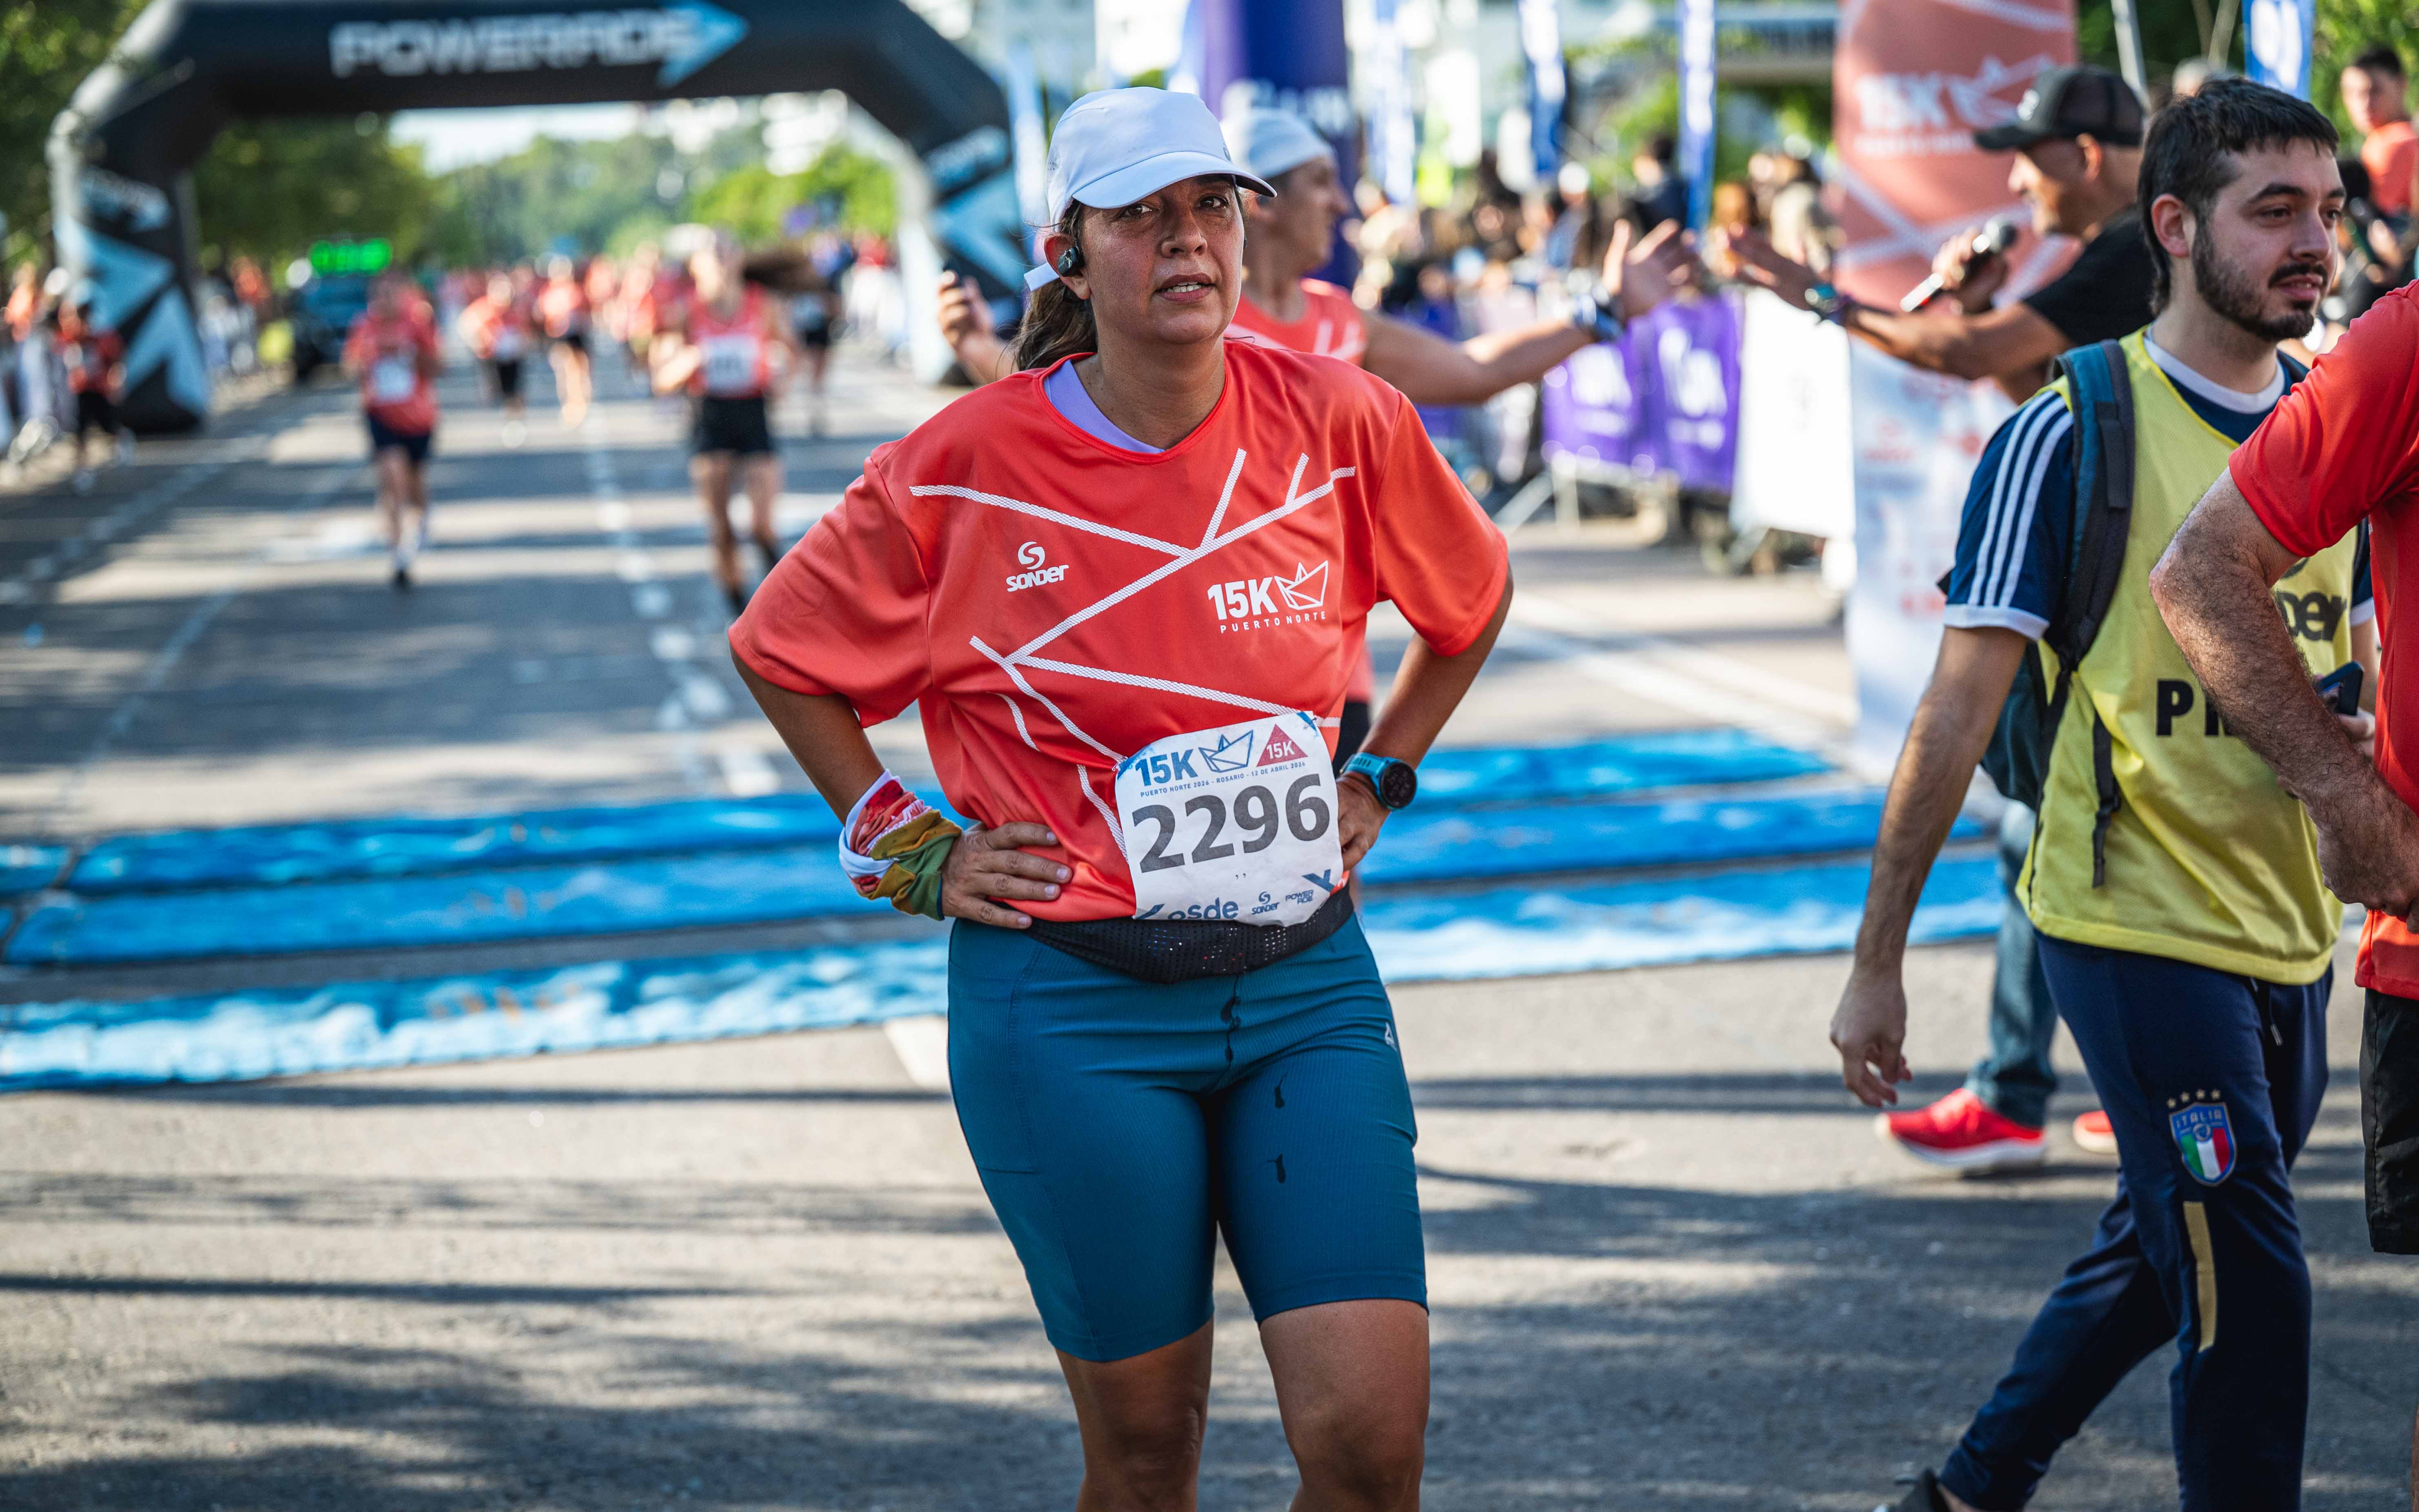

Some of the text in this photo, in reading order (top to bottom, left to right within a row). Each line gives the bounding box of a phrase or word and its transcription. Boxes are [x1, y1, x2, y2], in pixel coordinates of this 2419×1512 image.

[1207, 577, 1279, 620] 15K
[1220, 611, 1326, 634] PUERTO NORTE
[1266, 740, 1295, 759] 15K
[1135, 749, 1198, 786] 15K
[1140, 788, 1168, 797] PUERTO
[1170, 783, 1191, 792] NORTE
[1216, 773, 1244, 783] ROSARIO
[1271, 764, 1288, 773] ABRIL
[1132, 773, 1330, 873] 2296
